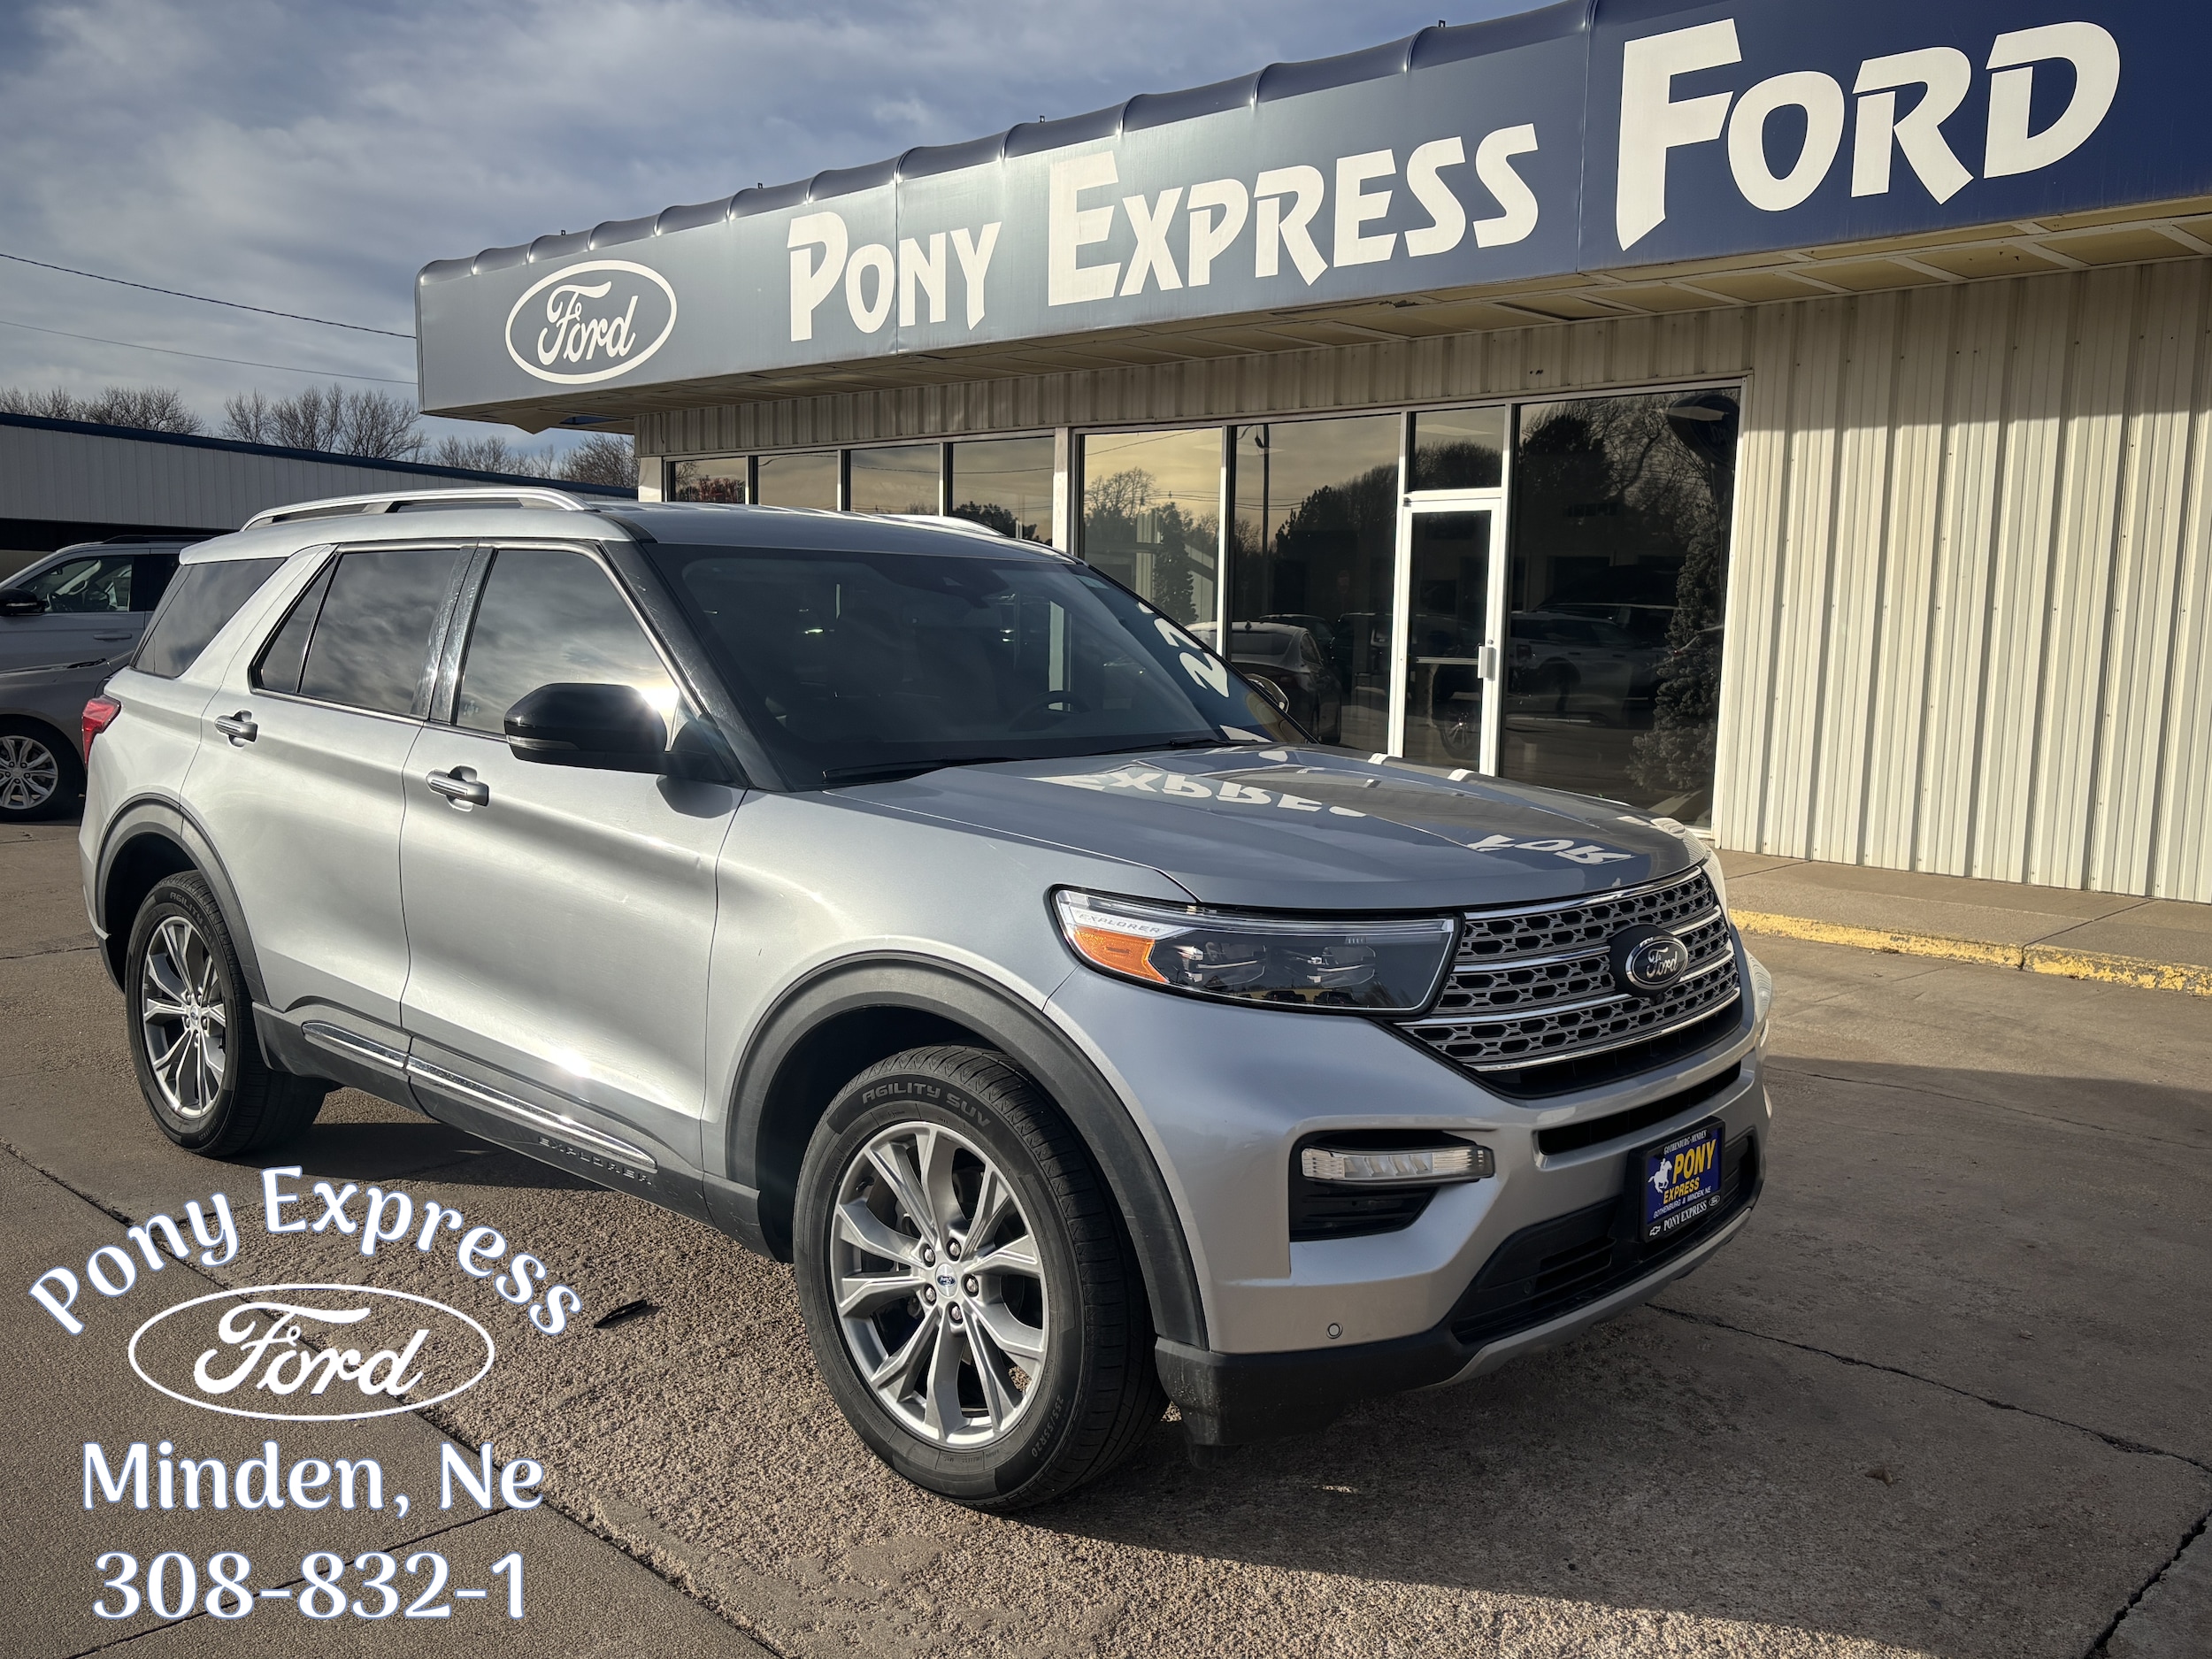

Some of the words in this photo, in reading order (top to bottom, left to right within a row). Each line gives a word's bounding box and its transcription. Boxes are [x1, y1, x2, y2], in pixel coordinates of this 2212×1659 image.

[787, 211, 1002, 342] PONY
[1047, 123, 1540, 307] EXPRESS
[1615, 18, 2122, 252] FORD
[536, 280, 641, 366] Ford
[170, 892, 204, 925] AGILITY
[1079, 913, 1161, 933] EXPLORER
[1646, 946, 1679, 979] Ford
[862, 1082, 941, 1104] AGILITY
[946, 1092, 991, 1127] SUV
[538, 1136, 652, 1186] EXPLORER
[1672, 1139, 1717, 1184] PONY
[1653, 1198, 1681, 1218] GOTHENBURG
[1663, 1177, 1700, 1204] EXPRESS
[1663, 1213, 1681, 1231] PONY
[1681, 1200, 1708, 1223] EXPRESS
[1031, 1394, 1064, 1457] 255/55R20
